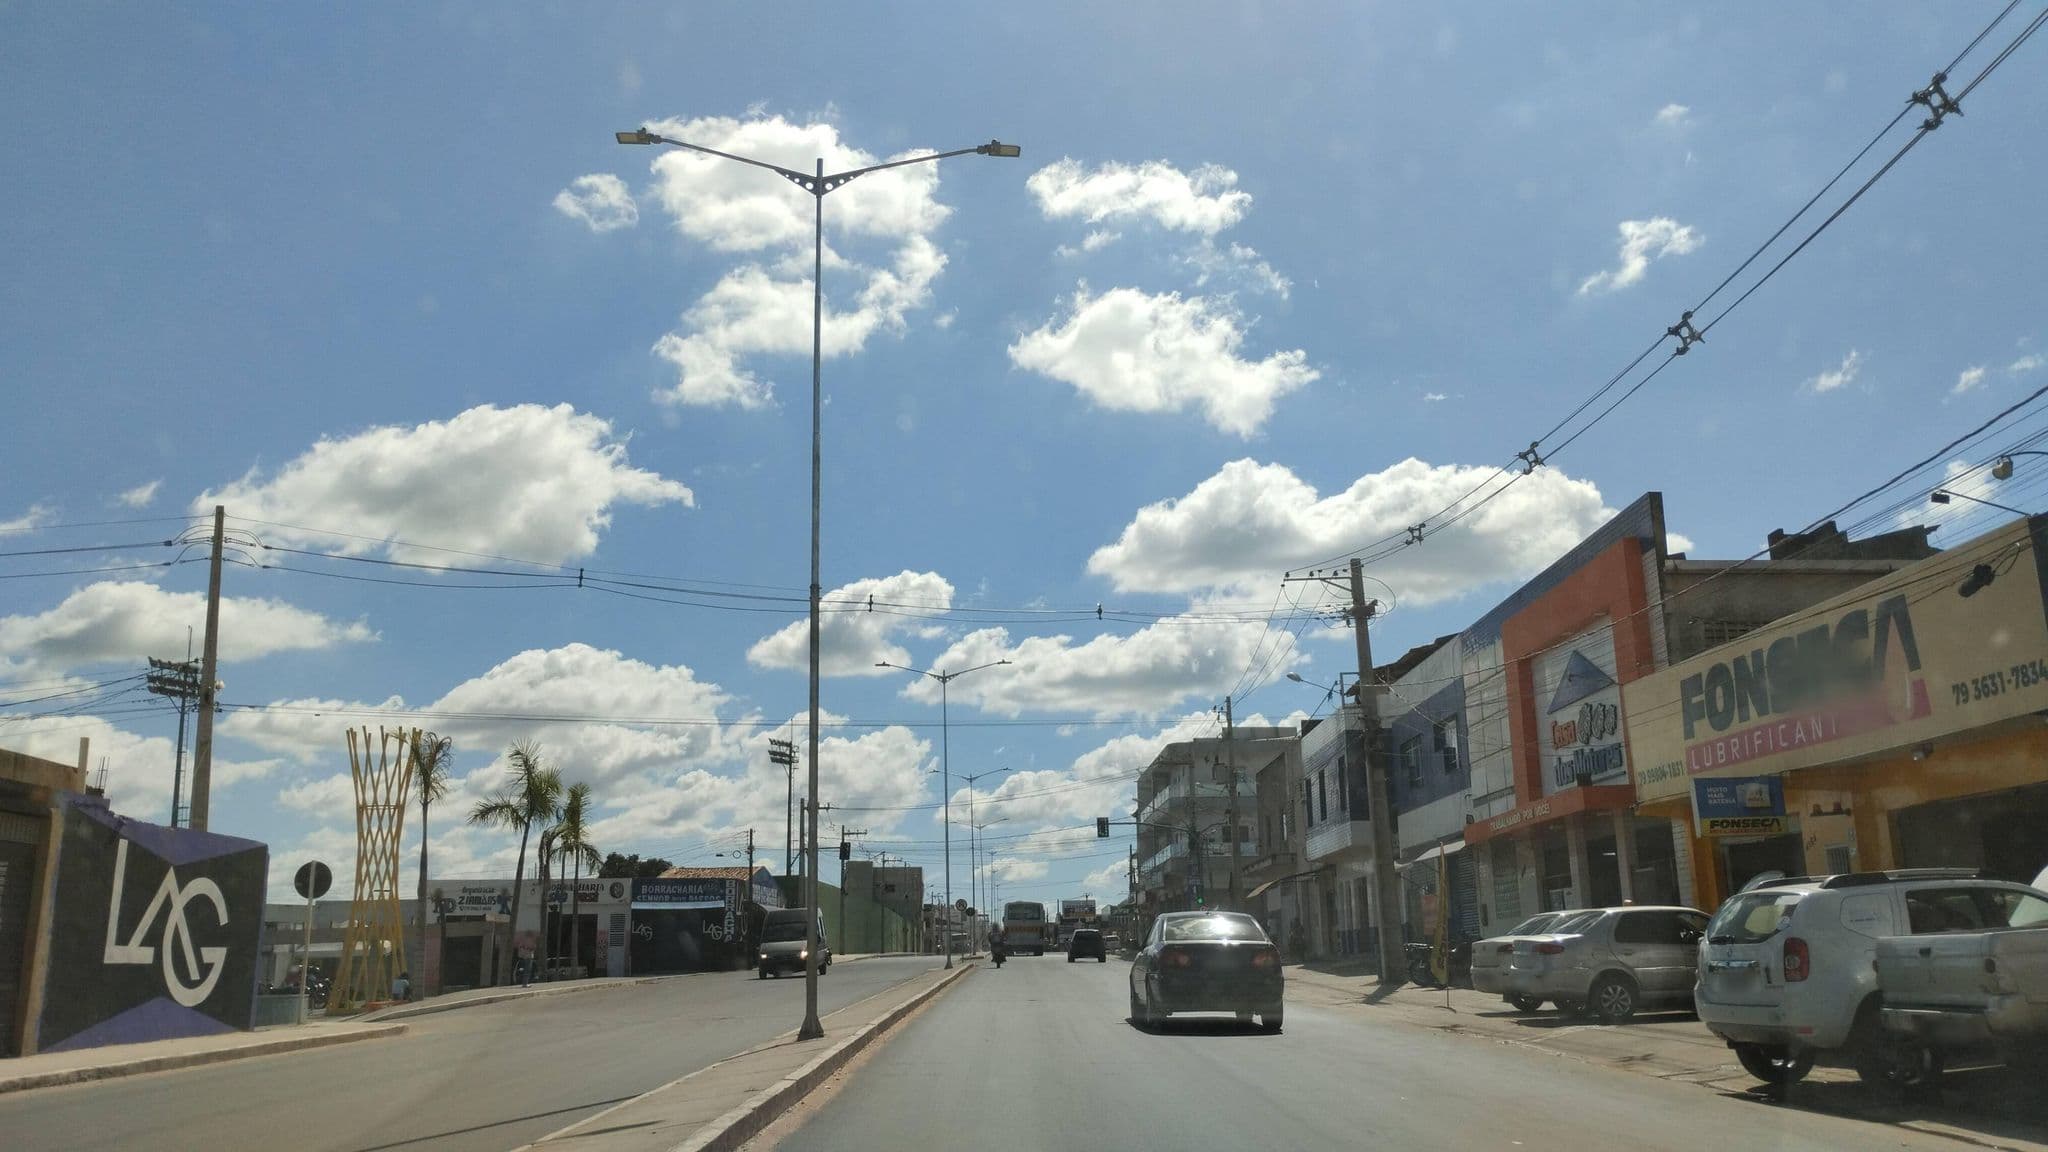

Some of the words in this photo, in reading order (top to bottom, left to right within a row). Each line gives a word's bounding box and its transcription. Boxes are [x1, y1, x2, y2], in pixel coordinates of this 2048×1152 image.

[1951, 681, 1969, 706] 79
[1709, 817, 1781, 829] FONSECA
[641, 884, 704, 895] BORRACHARIA
